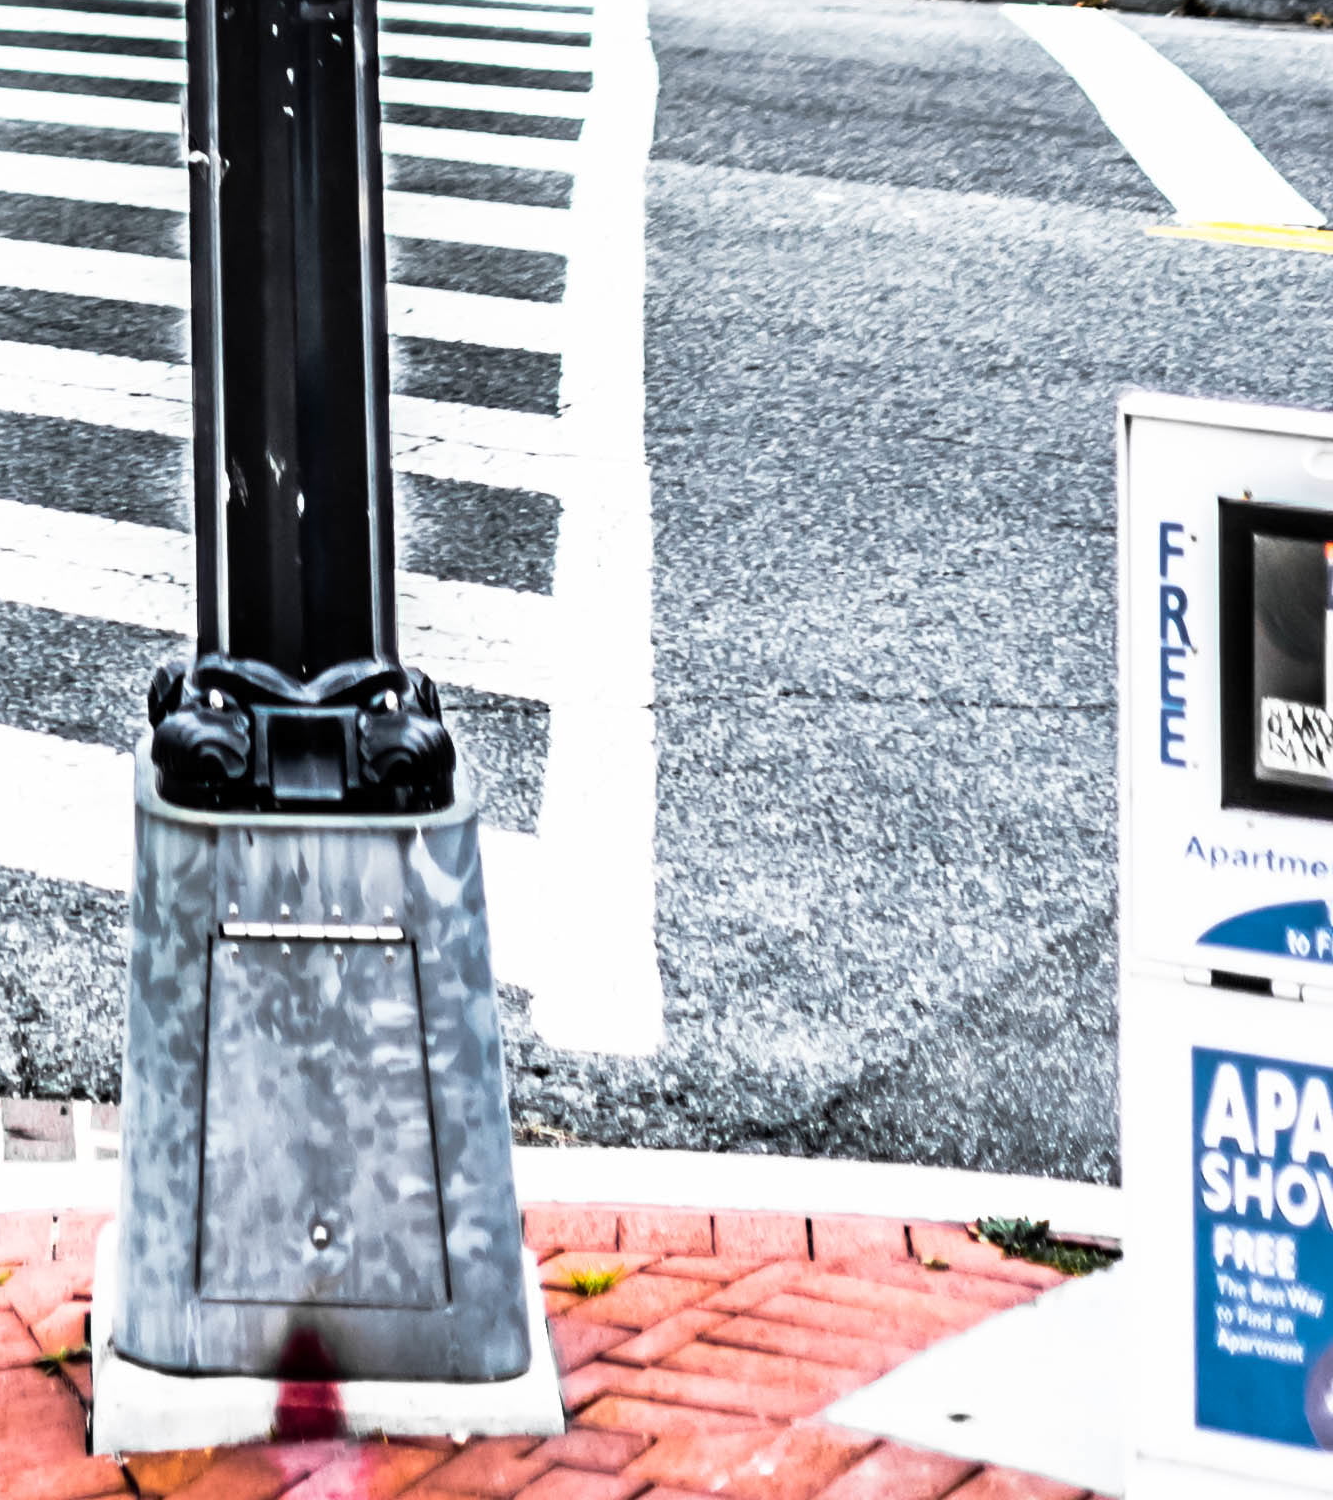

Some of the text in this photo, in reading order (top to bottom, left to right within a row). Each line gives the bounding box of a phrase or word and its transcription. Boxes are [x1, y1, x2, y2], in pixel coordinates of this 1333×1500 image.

[1159, 522, 1192, 767] FREE
[1285, 926, 1311, 957] to
[1214, 1224, 1296, 1280] FREE
[1217, 1327, 1303, 1364] Apartment
